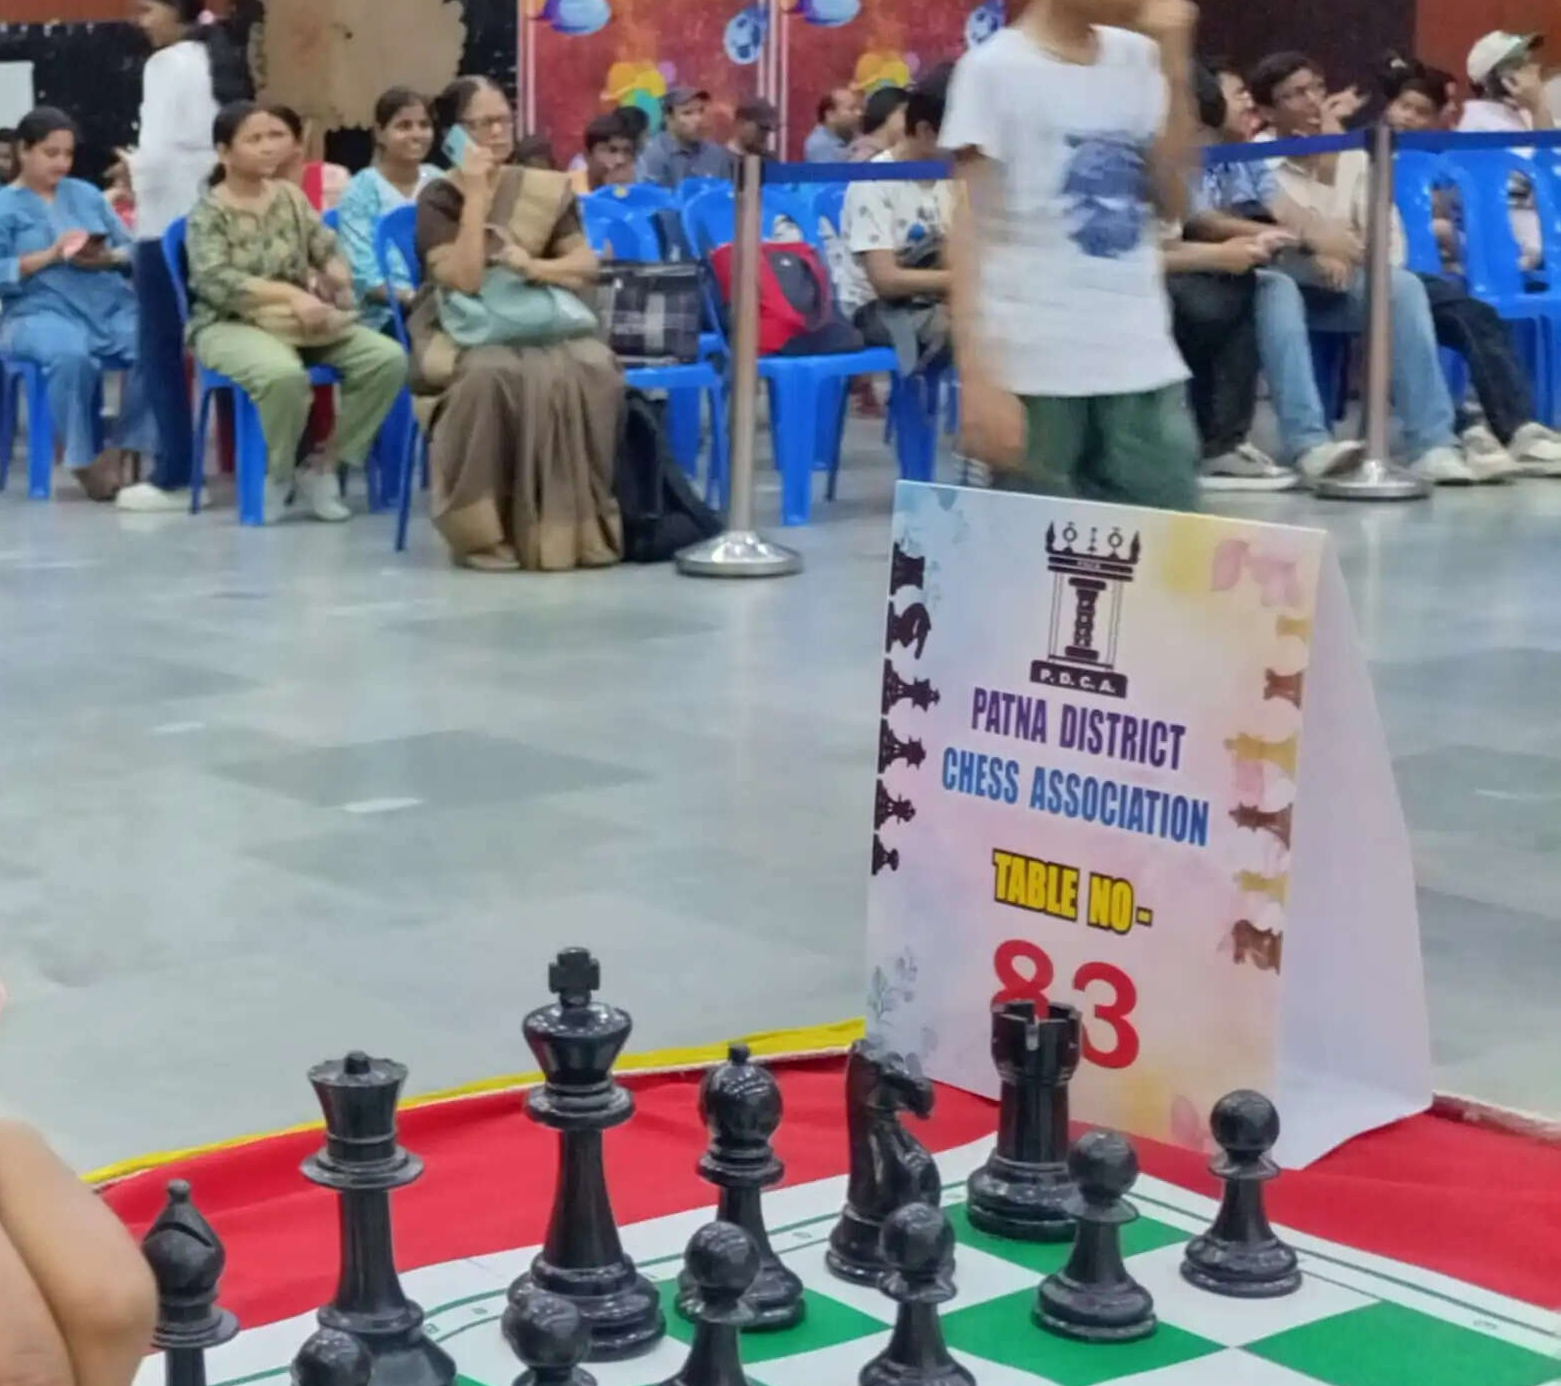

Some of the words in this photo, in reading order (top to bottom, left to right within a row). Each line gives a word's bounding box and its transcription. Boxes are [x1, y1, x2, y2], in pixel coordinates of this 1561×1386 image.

[971, 687, 1047, 743] PATNA
[1059, 704, 1186, 770] DISTRICT
[942, 747, 1020, 804] CHESS
[1029, 766, 1209, 847] ASSOCIATION
[992, 848, 1080, 922] TABLE
[990, 939, 1139, 1069] 83
